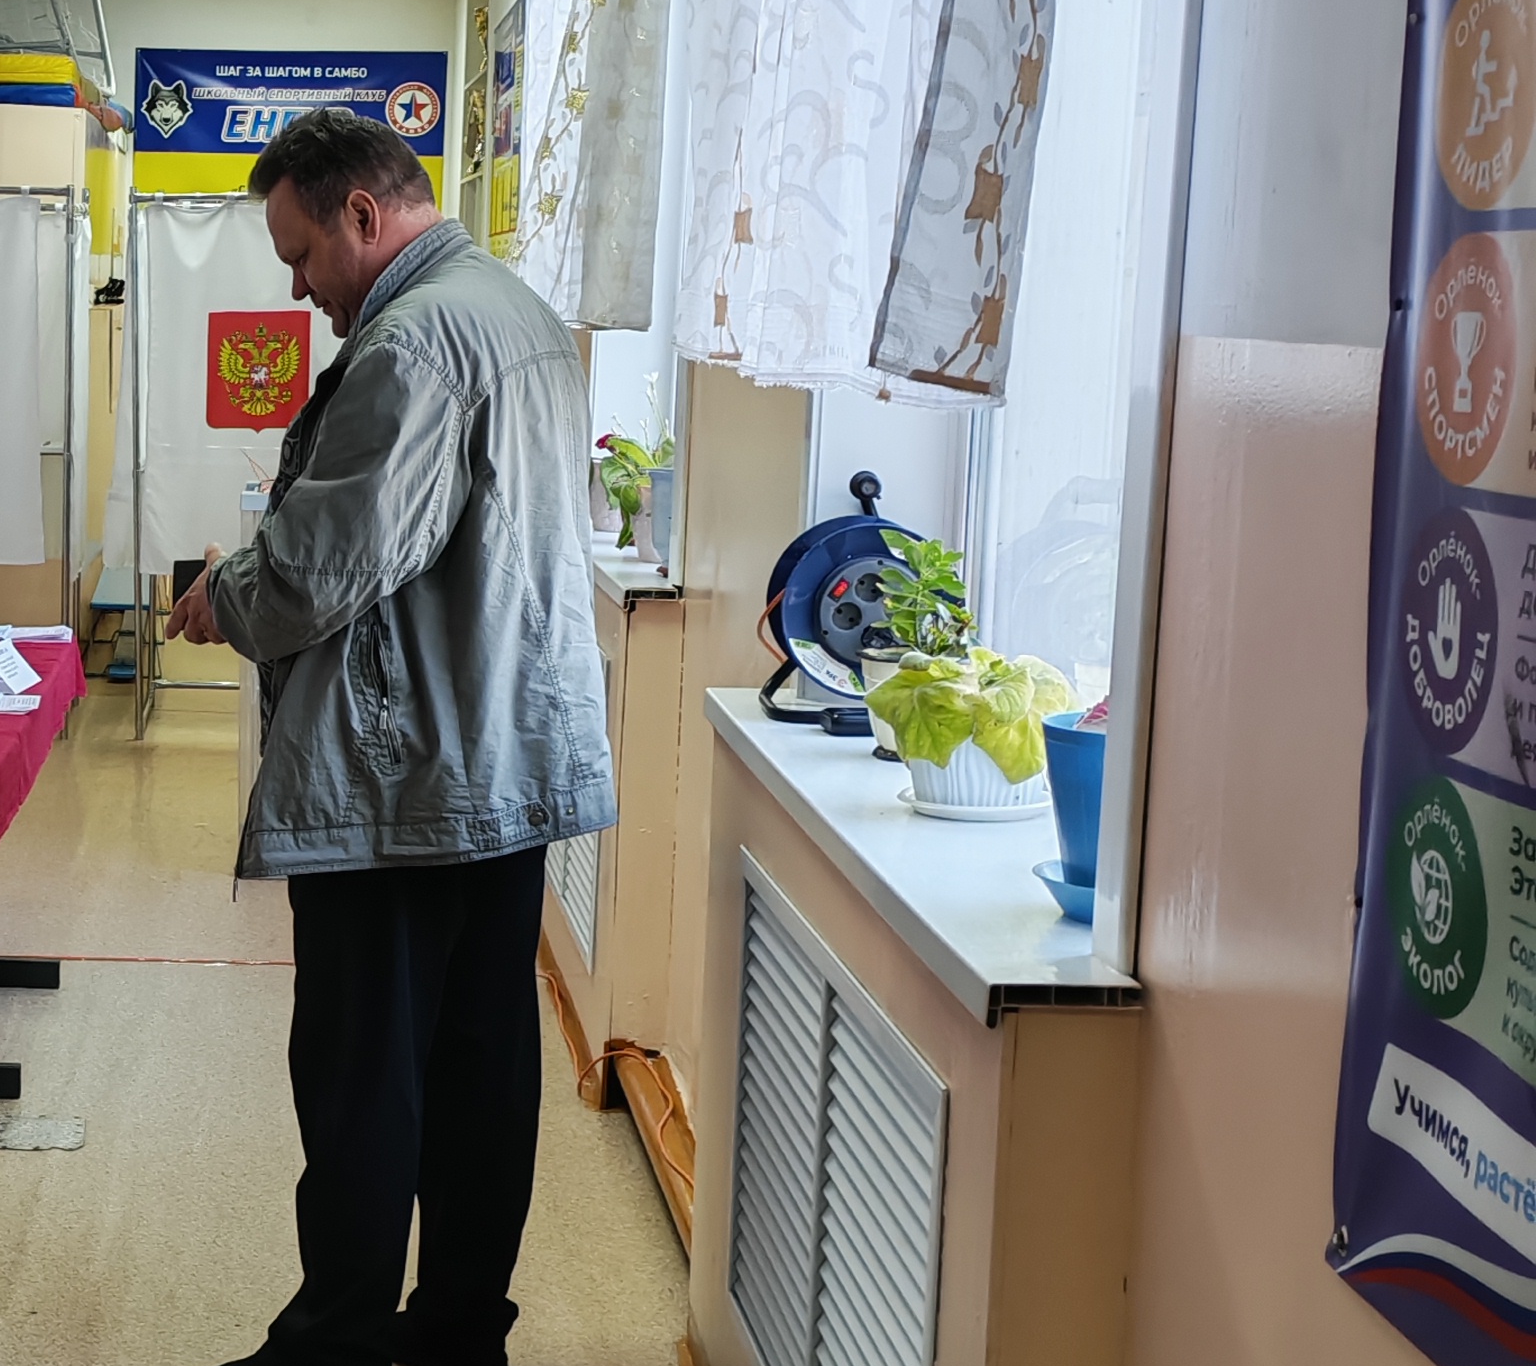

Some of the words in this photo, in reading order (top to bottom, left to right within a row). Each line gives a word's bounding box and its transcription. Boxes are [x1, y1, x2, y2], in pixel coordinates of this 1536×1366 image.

[192, 87, 267, 100] ШКОЛЬНЫЙ
[268, 88, 352, 102] СПОРТИВНЫЙ
[353, 89, 387, 102] КЛУБ
[216, 65, 245, 78] ШАГ
[246, 65, 262, 78] ЗА
[265, 66, 311, 78] ШАГОМ
[313, 67, 323, 78] В
[325, 66, 368, 79] САМБО
[1450, 134, 1514, 194] ЛИДЕР
[1424, 364, 1506, 460] СПОРТСМЕН
[1405, 613, 1491, 730] ДОБРОВОЛЕЦ
[1401, 927, 1465, 996] ЭКОЛОГ
[1393, 1077, 1471, 1179] Учимся,
